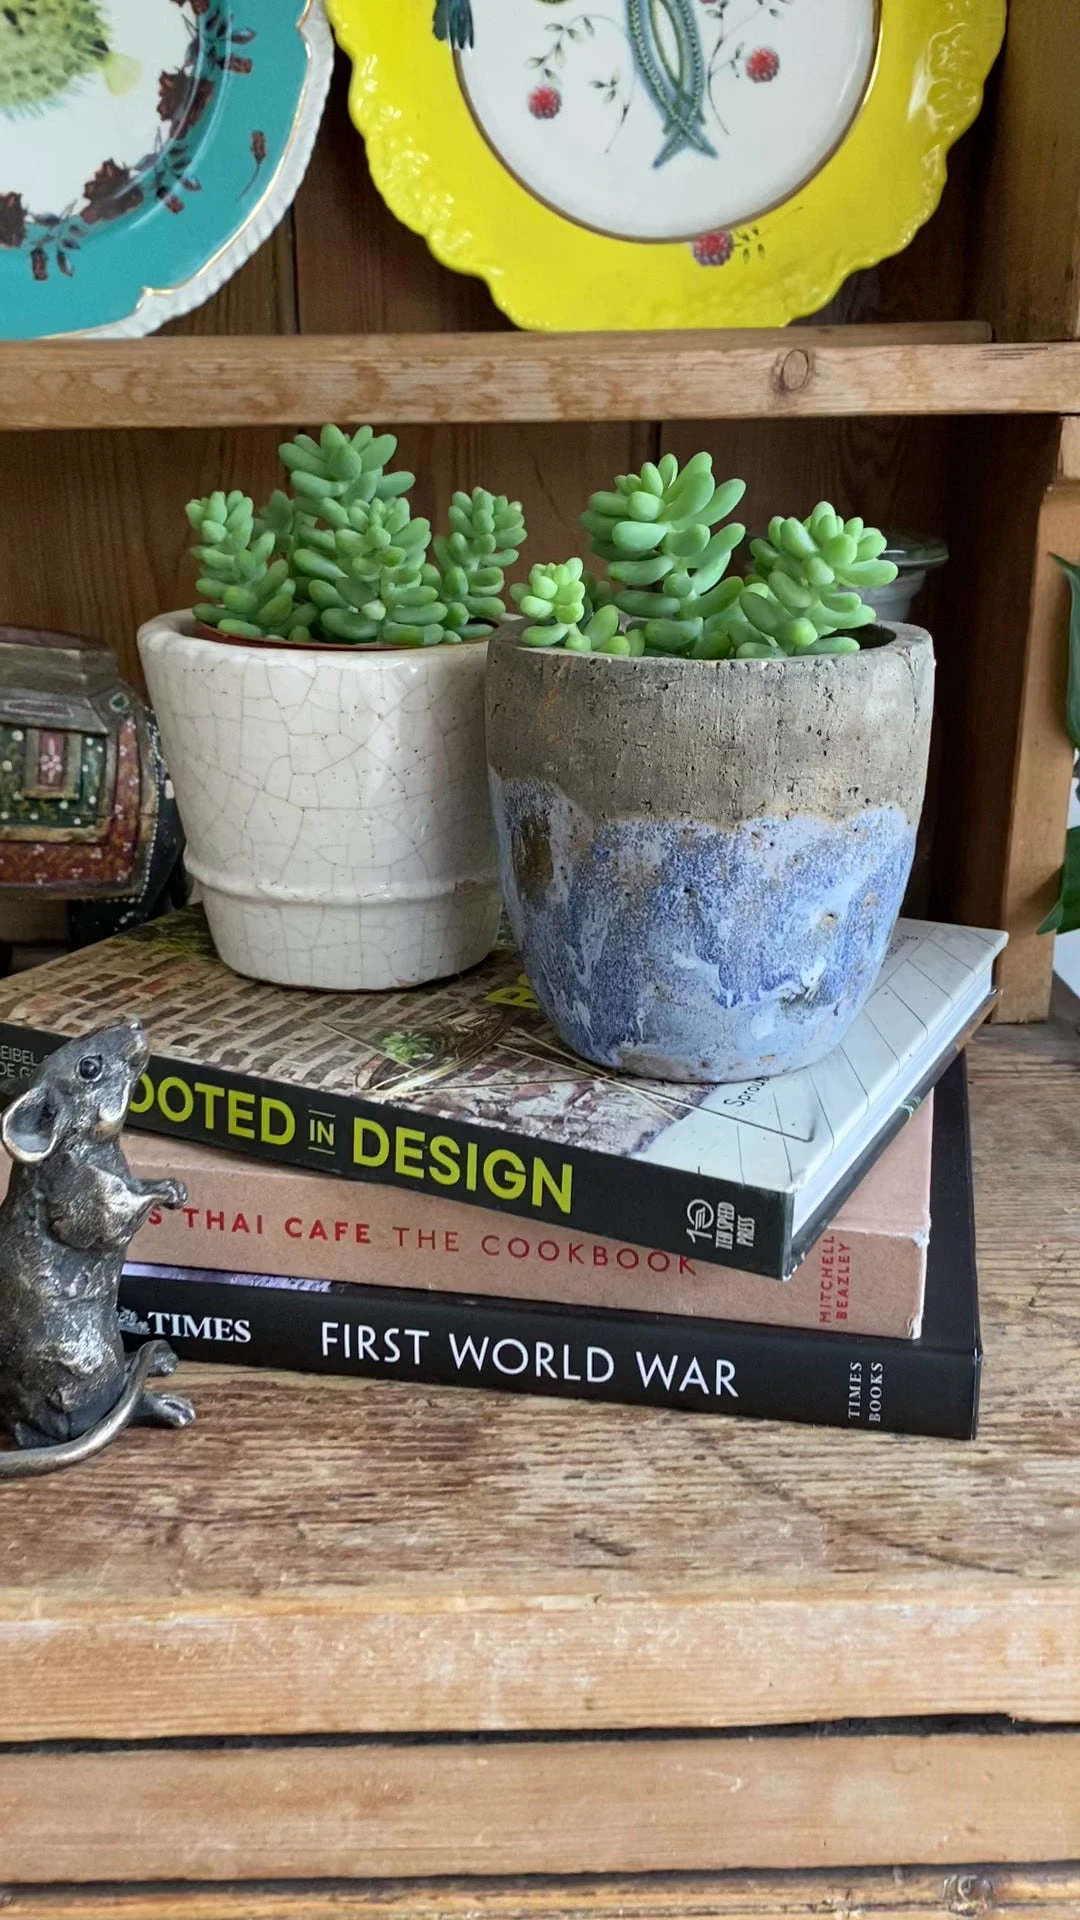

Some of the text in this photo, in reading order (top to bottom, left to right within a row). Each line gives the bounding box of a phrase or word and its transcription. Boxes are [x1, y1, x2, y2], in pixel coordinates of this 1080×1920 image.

[0, 1045, 40, 1067] EIBEL
[129, 1073, 574, 1214] OOTED IN DESIGN
[182, 1208, 263, 1235] THAI
[284, 1217, 372, 1245] CAFE
[392, 1226, 460, 1252] THE
[481, 1234, 697, 1276] COOKBOOK
[819, 1235, 835, 1324] MITCHELL
[836, 1242, 851, 1320] BEAZLEY
[147, 1311, 740, 1398] TIMES FIRST WORLD WAR
[847, 1361, 863, 1420] TIMES
[868, 1361, 885, 1423] BOOKS
